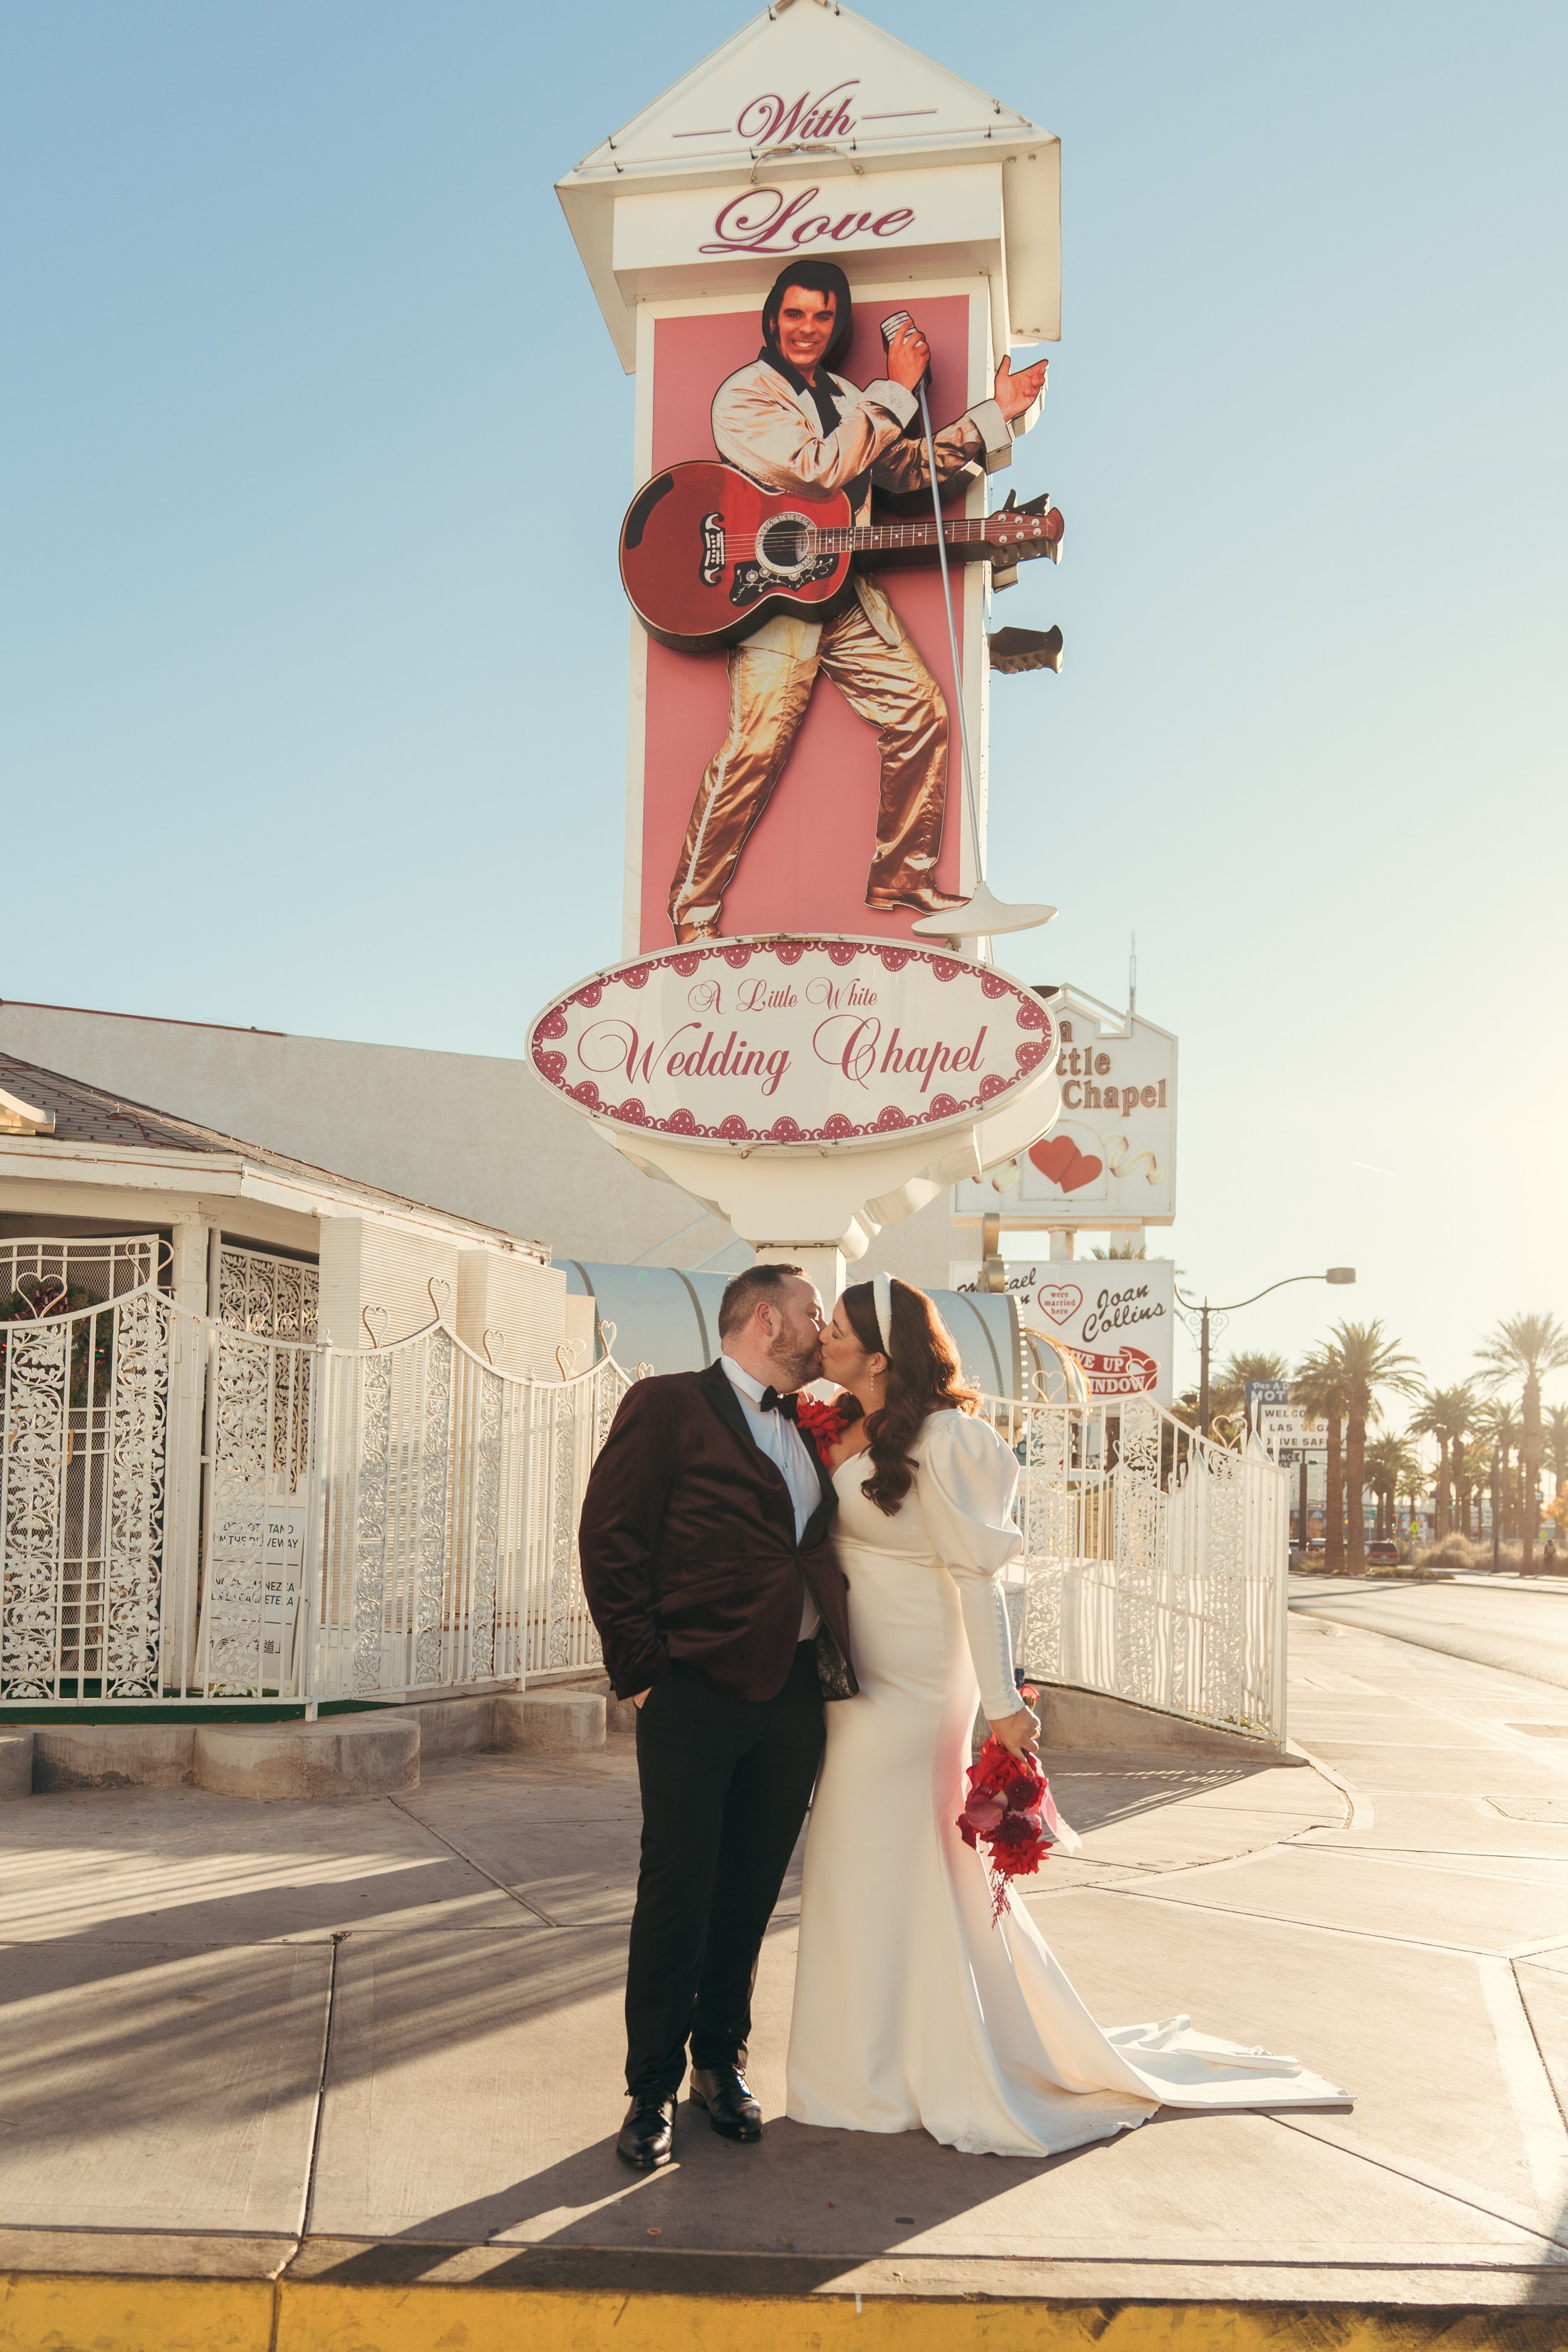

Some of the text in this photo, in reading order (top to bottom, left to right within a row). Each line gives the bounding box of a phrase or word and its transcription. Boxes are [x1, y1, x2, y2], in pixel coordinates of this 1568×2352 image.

[736, 78, 860, 146] With
[697, 185, 917, 254] Love
[687, 976, 878, 1015] A Little White
[577, 1013, 988, 1096] Wedding Chapel
[1056, 1046, 1110, 1076] ttle
[1061, 1078, 1167, 1117] Chapel
[1044, 1299, 1076, 1307] married
[1096, 1284, 1149, 1320] Joan
[1082, 1302, 1167, 1343] Collins
[1103, 1356, 1124, 1372] UP
[1090, 1375, 1145, 1393] INDOW
[1251, 1390, 1286, 1401] MOT
[1264, 1409, 1306, 1418] WELCO
[1269, 1423, 1293, 1432] LAS
[268, 1523, 294, 1535] TAND
